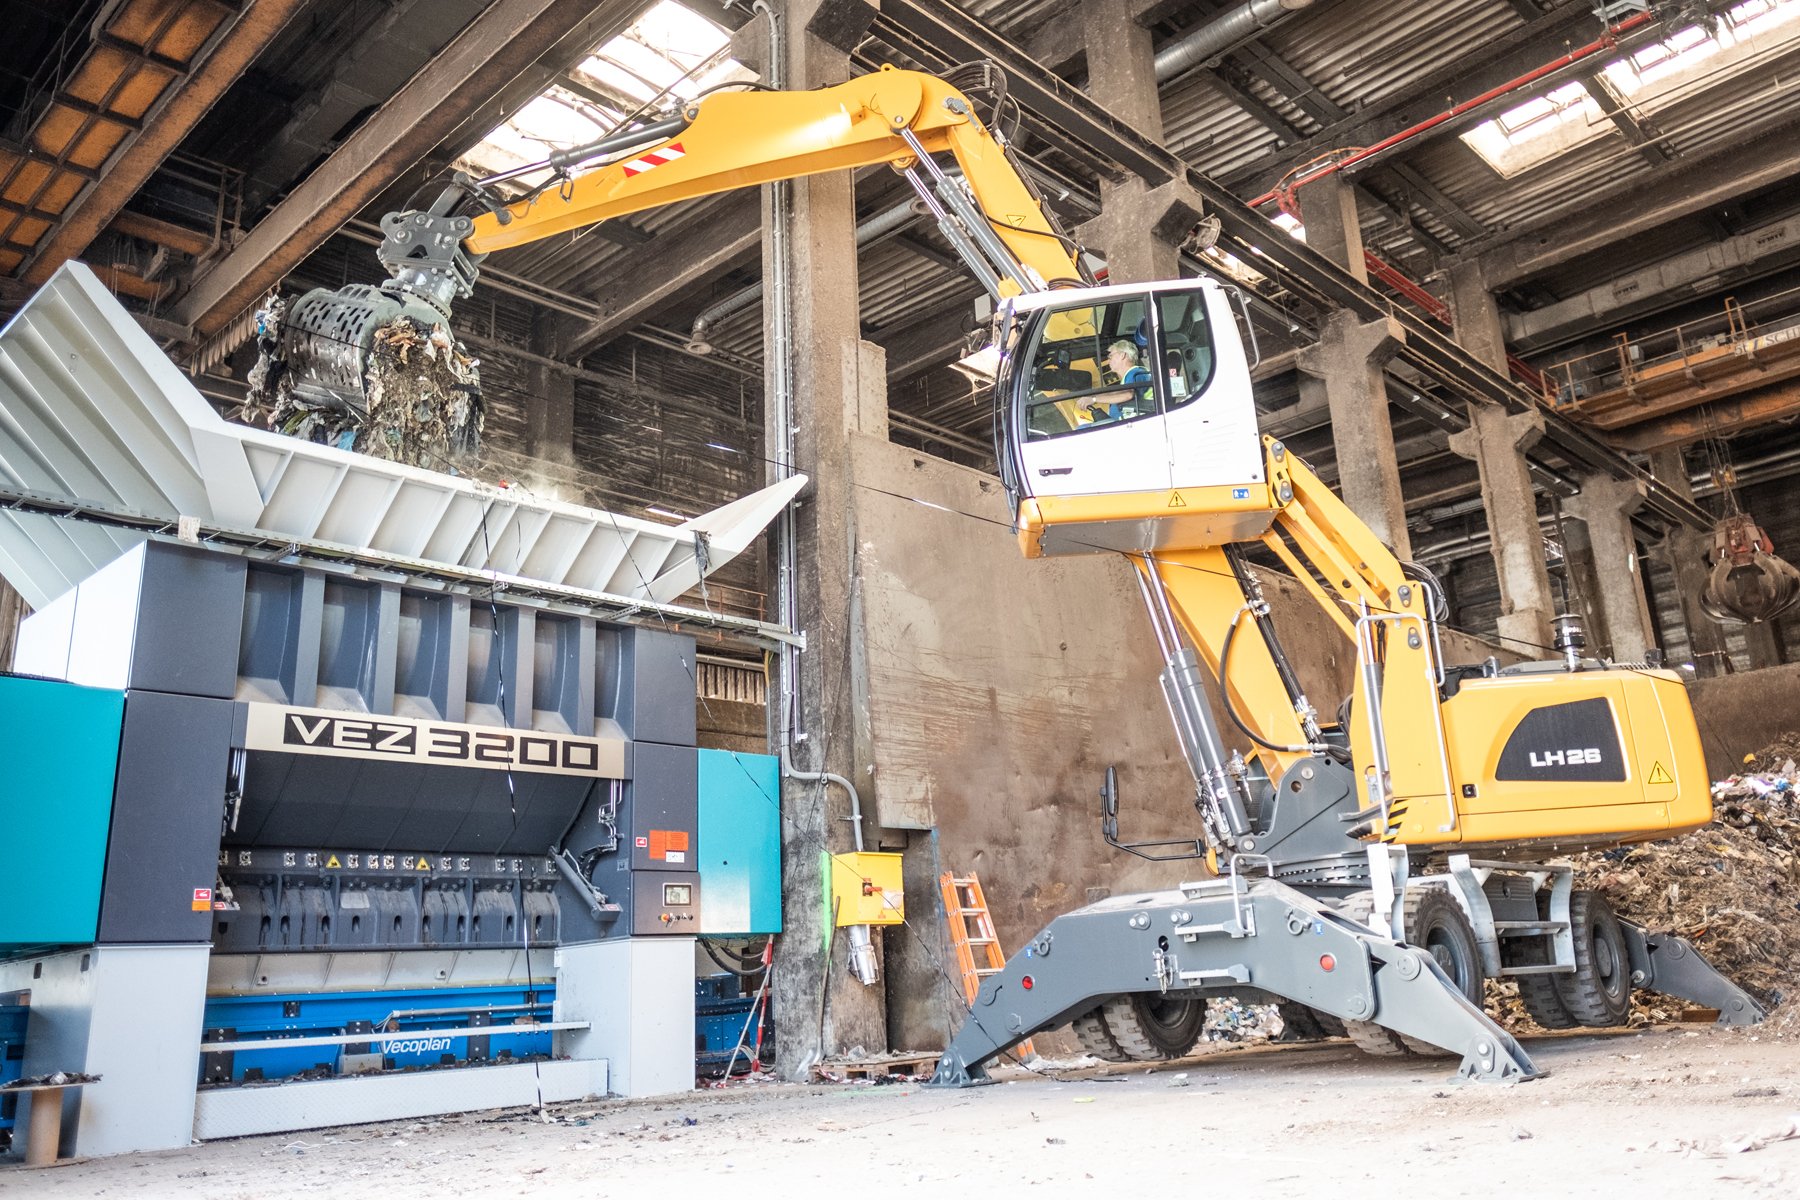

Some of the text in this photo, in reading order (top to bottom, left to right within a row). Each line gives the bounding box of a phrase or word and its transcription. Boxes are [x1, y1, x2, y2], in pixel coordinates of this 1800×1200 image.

[290, 715, 598, 771] VEZ 3200
[383, 1038, 451, 1056] Vecoplan
